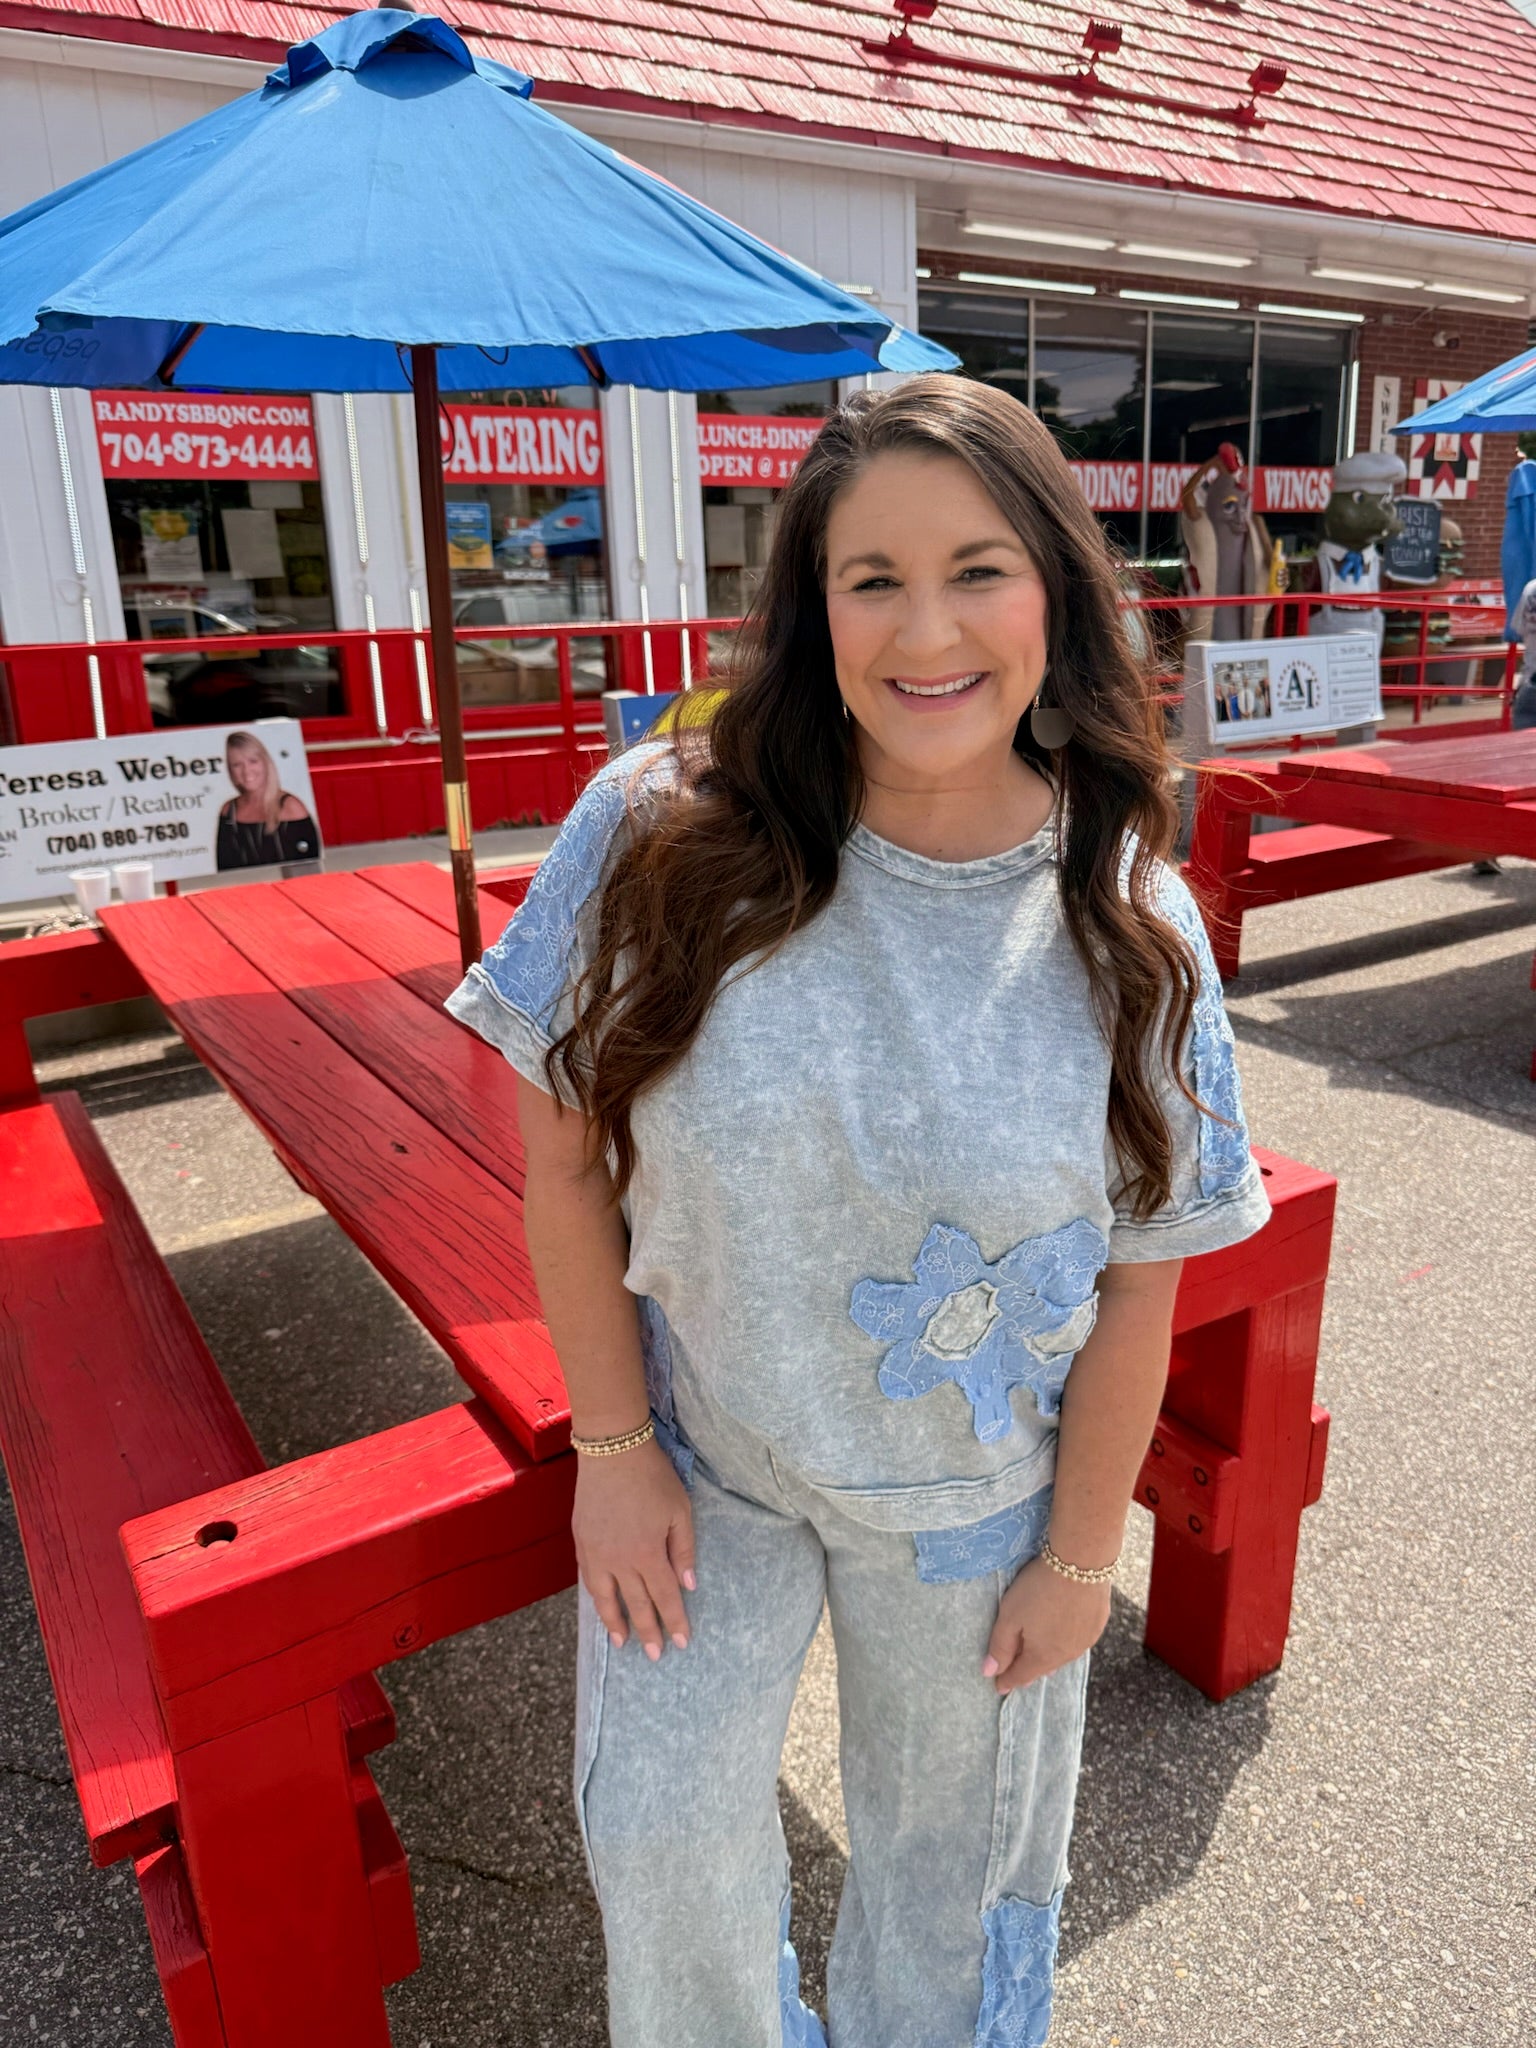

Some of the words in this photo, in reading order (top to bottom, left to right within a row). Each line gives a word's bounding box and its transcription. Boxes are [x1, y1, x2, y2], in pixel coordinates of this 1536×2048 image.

[96, 401, 311, 429] RANDYSBBQNC.COM
[1381, 382, 1391, 453] SWEE
[102, 431, 314, 469] 704-873-4444
[697, 424, 819, 450] LUNCH-DINN
[699, 454, 753, 477] OPEN
[757, 456, 774, 478] @
[1264, 469, 1331, 509] WINGS
[116, 756, 223, 782] Weber
[18, 803, 102, 829] Broker
[47, 832, 97, 854] (704)
[102, 822, 189, 848] 880-7630
